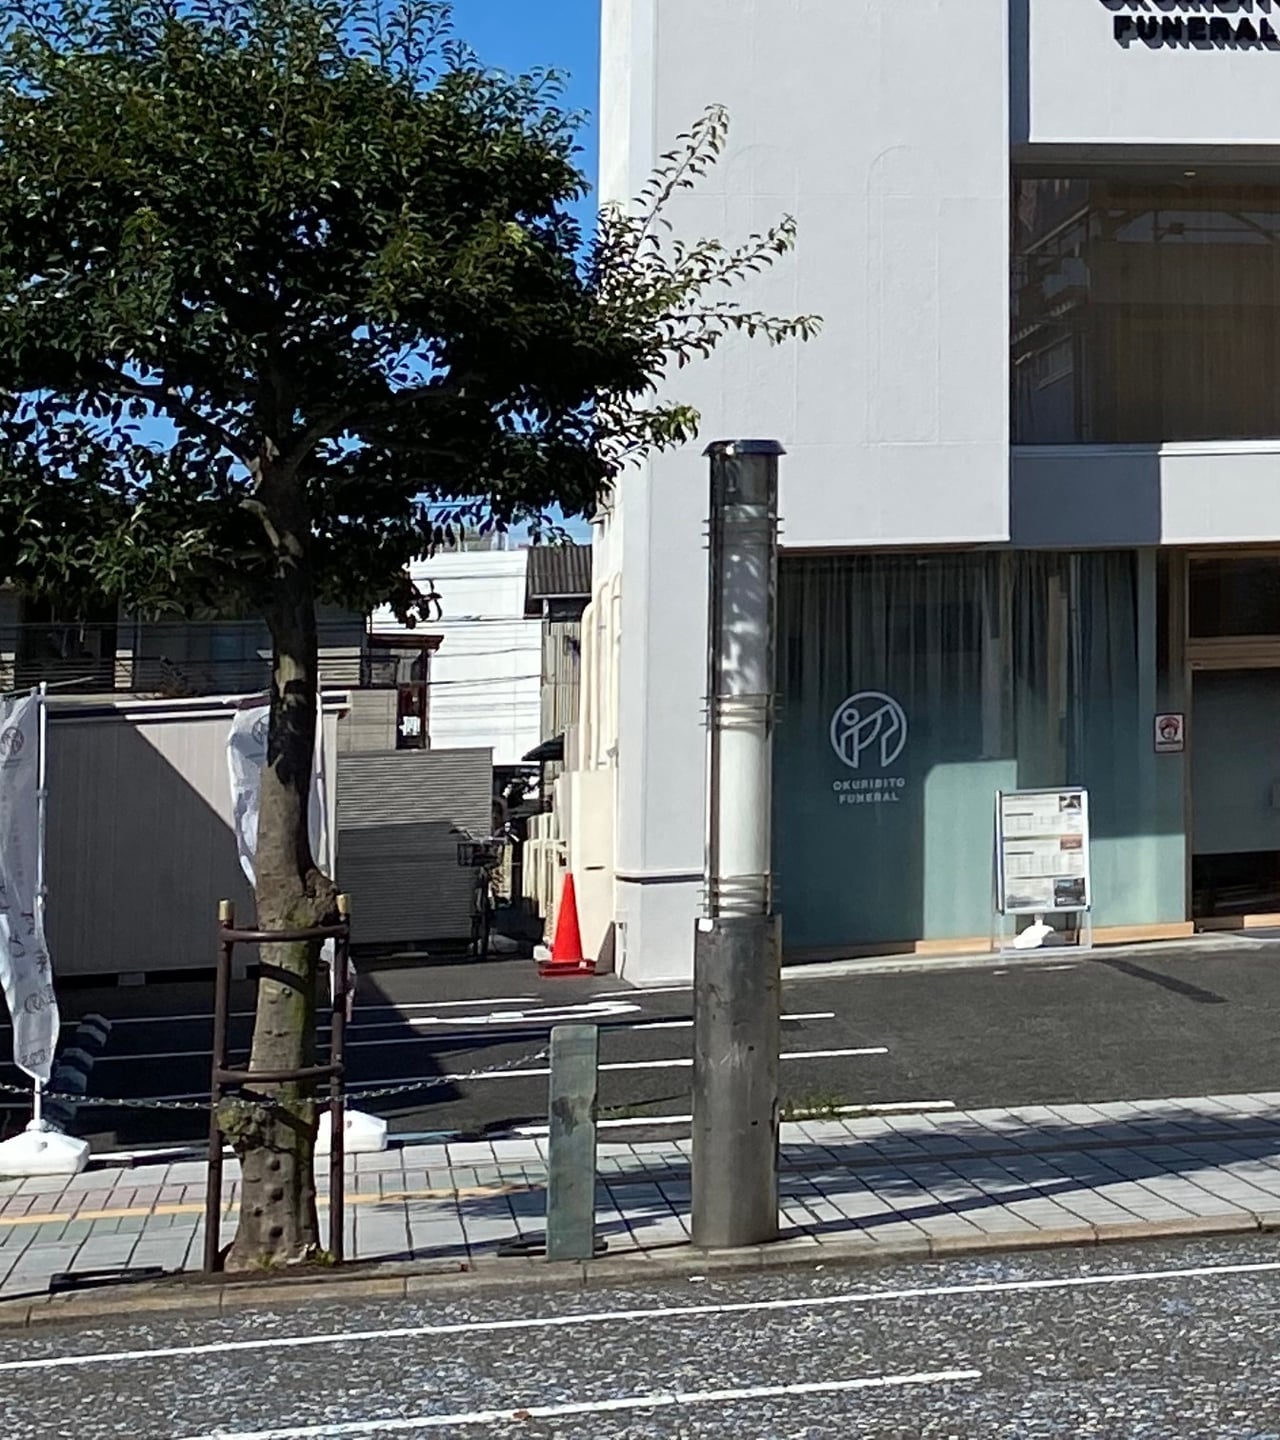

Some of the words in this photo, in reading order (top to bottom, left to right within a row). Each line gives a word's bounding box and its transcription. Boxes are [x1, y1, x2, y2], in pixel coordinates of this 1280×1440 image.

[1114, 15, 1280, 45] FUNERAL
[832, 777, 906, 790] OKURIBITO
[839, 791, 899, 804] FUNERAL
